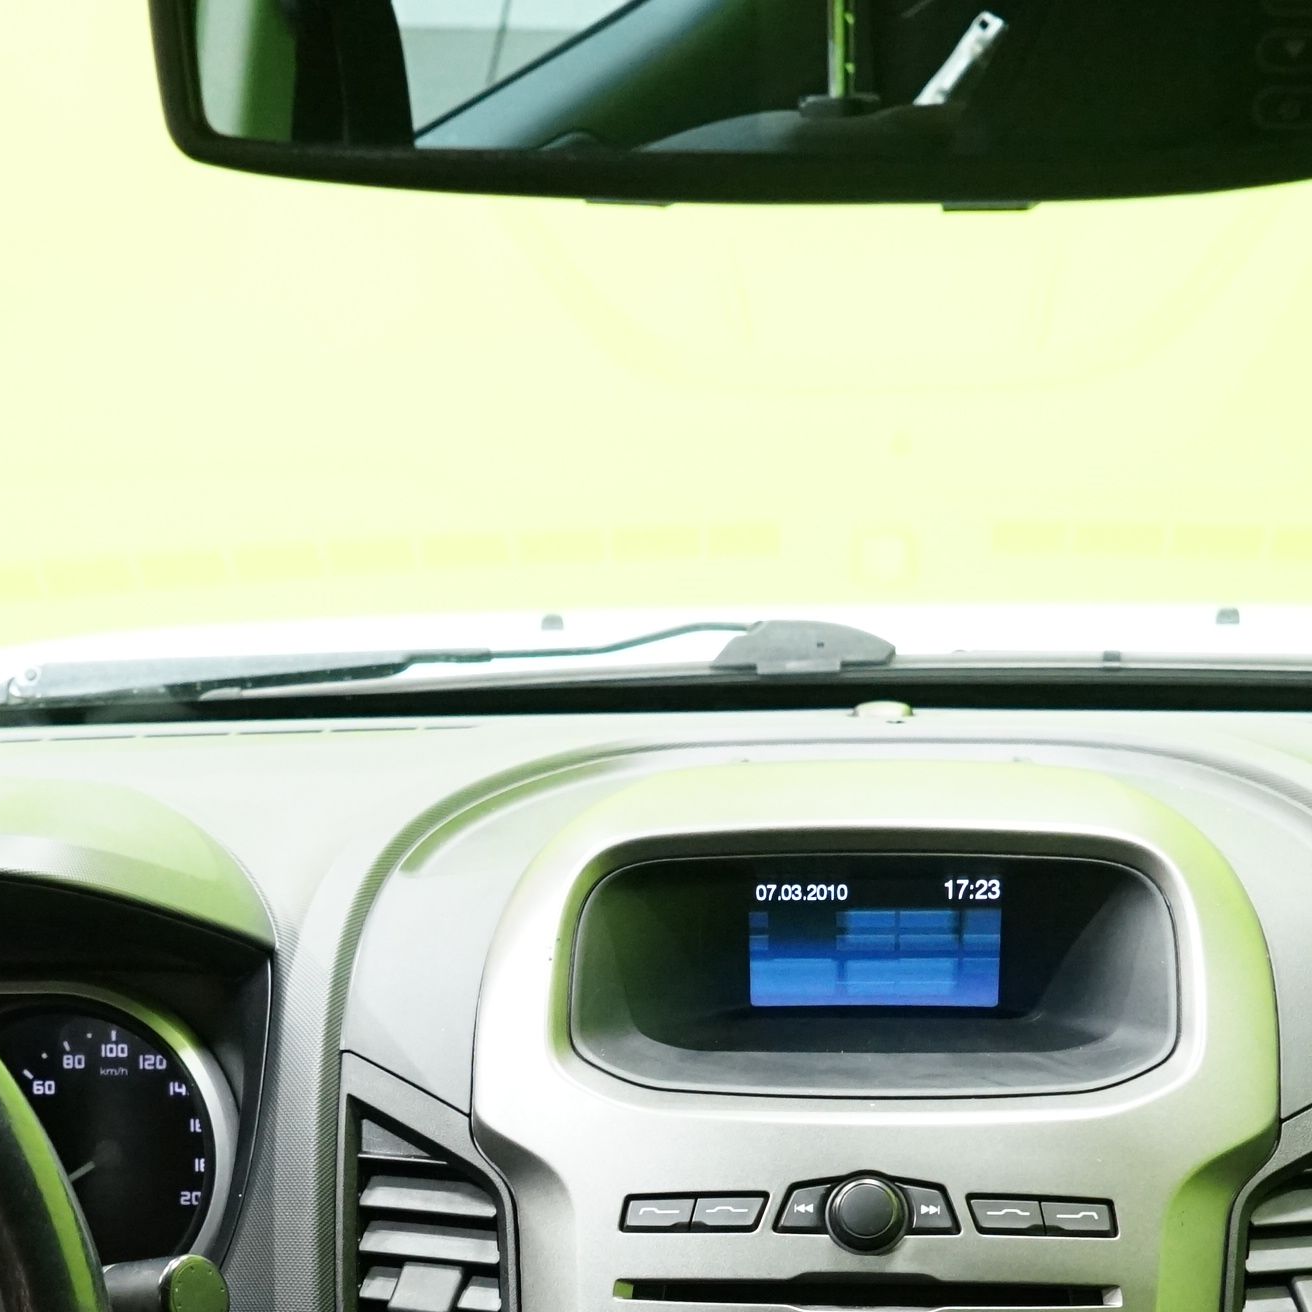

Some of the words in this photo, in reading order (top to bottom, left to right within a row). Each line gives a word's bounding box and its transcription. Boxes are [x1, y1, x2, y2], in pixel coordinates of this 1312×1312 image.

[755, 884, 848, 901] 07.03.2010
[944, 879, 1001, 900] 17:23
[101, 1043, 128, 1058] 100
[62, 1054, 86, 1069] 80
[138, 1054, 167, 1070] 120
[99, 1066, 128, 1076] km/h
[32, 1080, 56, 1095] 60
